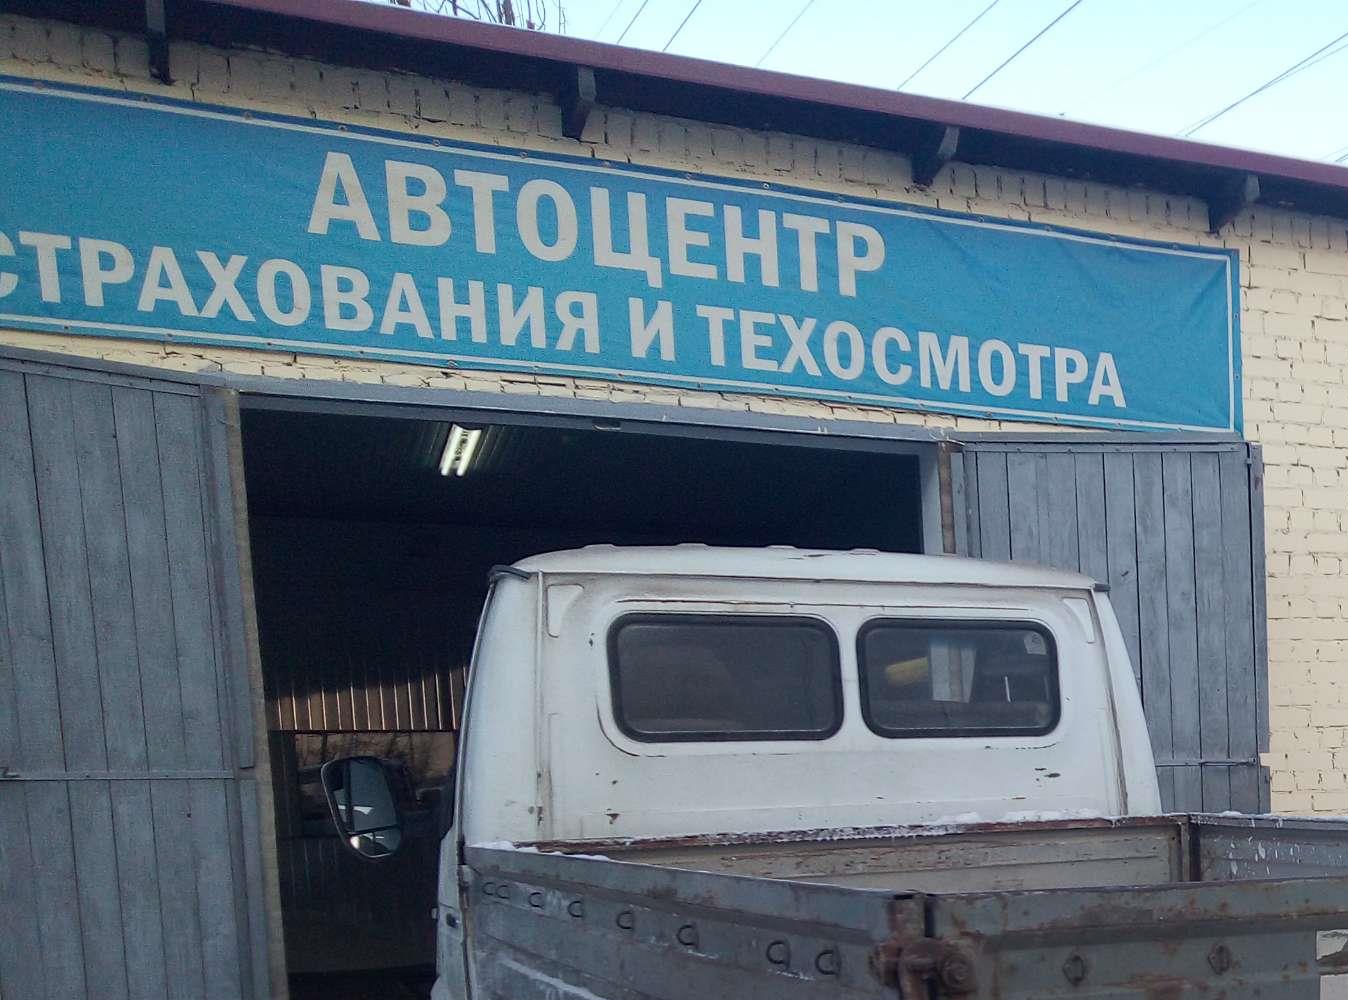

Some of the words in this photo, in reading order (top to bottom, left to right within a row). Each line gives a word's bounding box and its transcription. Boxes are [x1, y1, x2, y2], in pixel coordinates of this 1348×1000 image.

[306, 150, 886, 297] АВТОЦЕНТР
[628, 297, 675, 361] И
[696, 304, 1127, 408] ТЕХОСМОТРА
